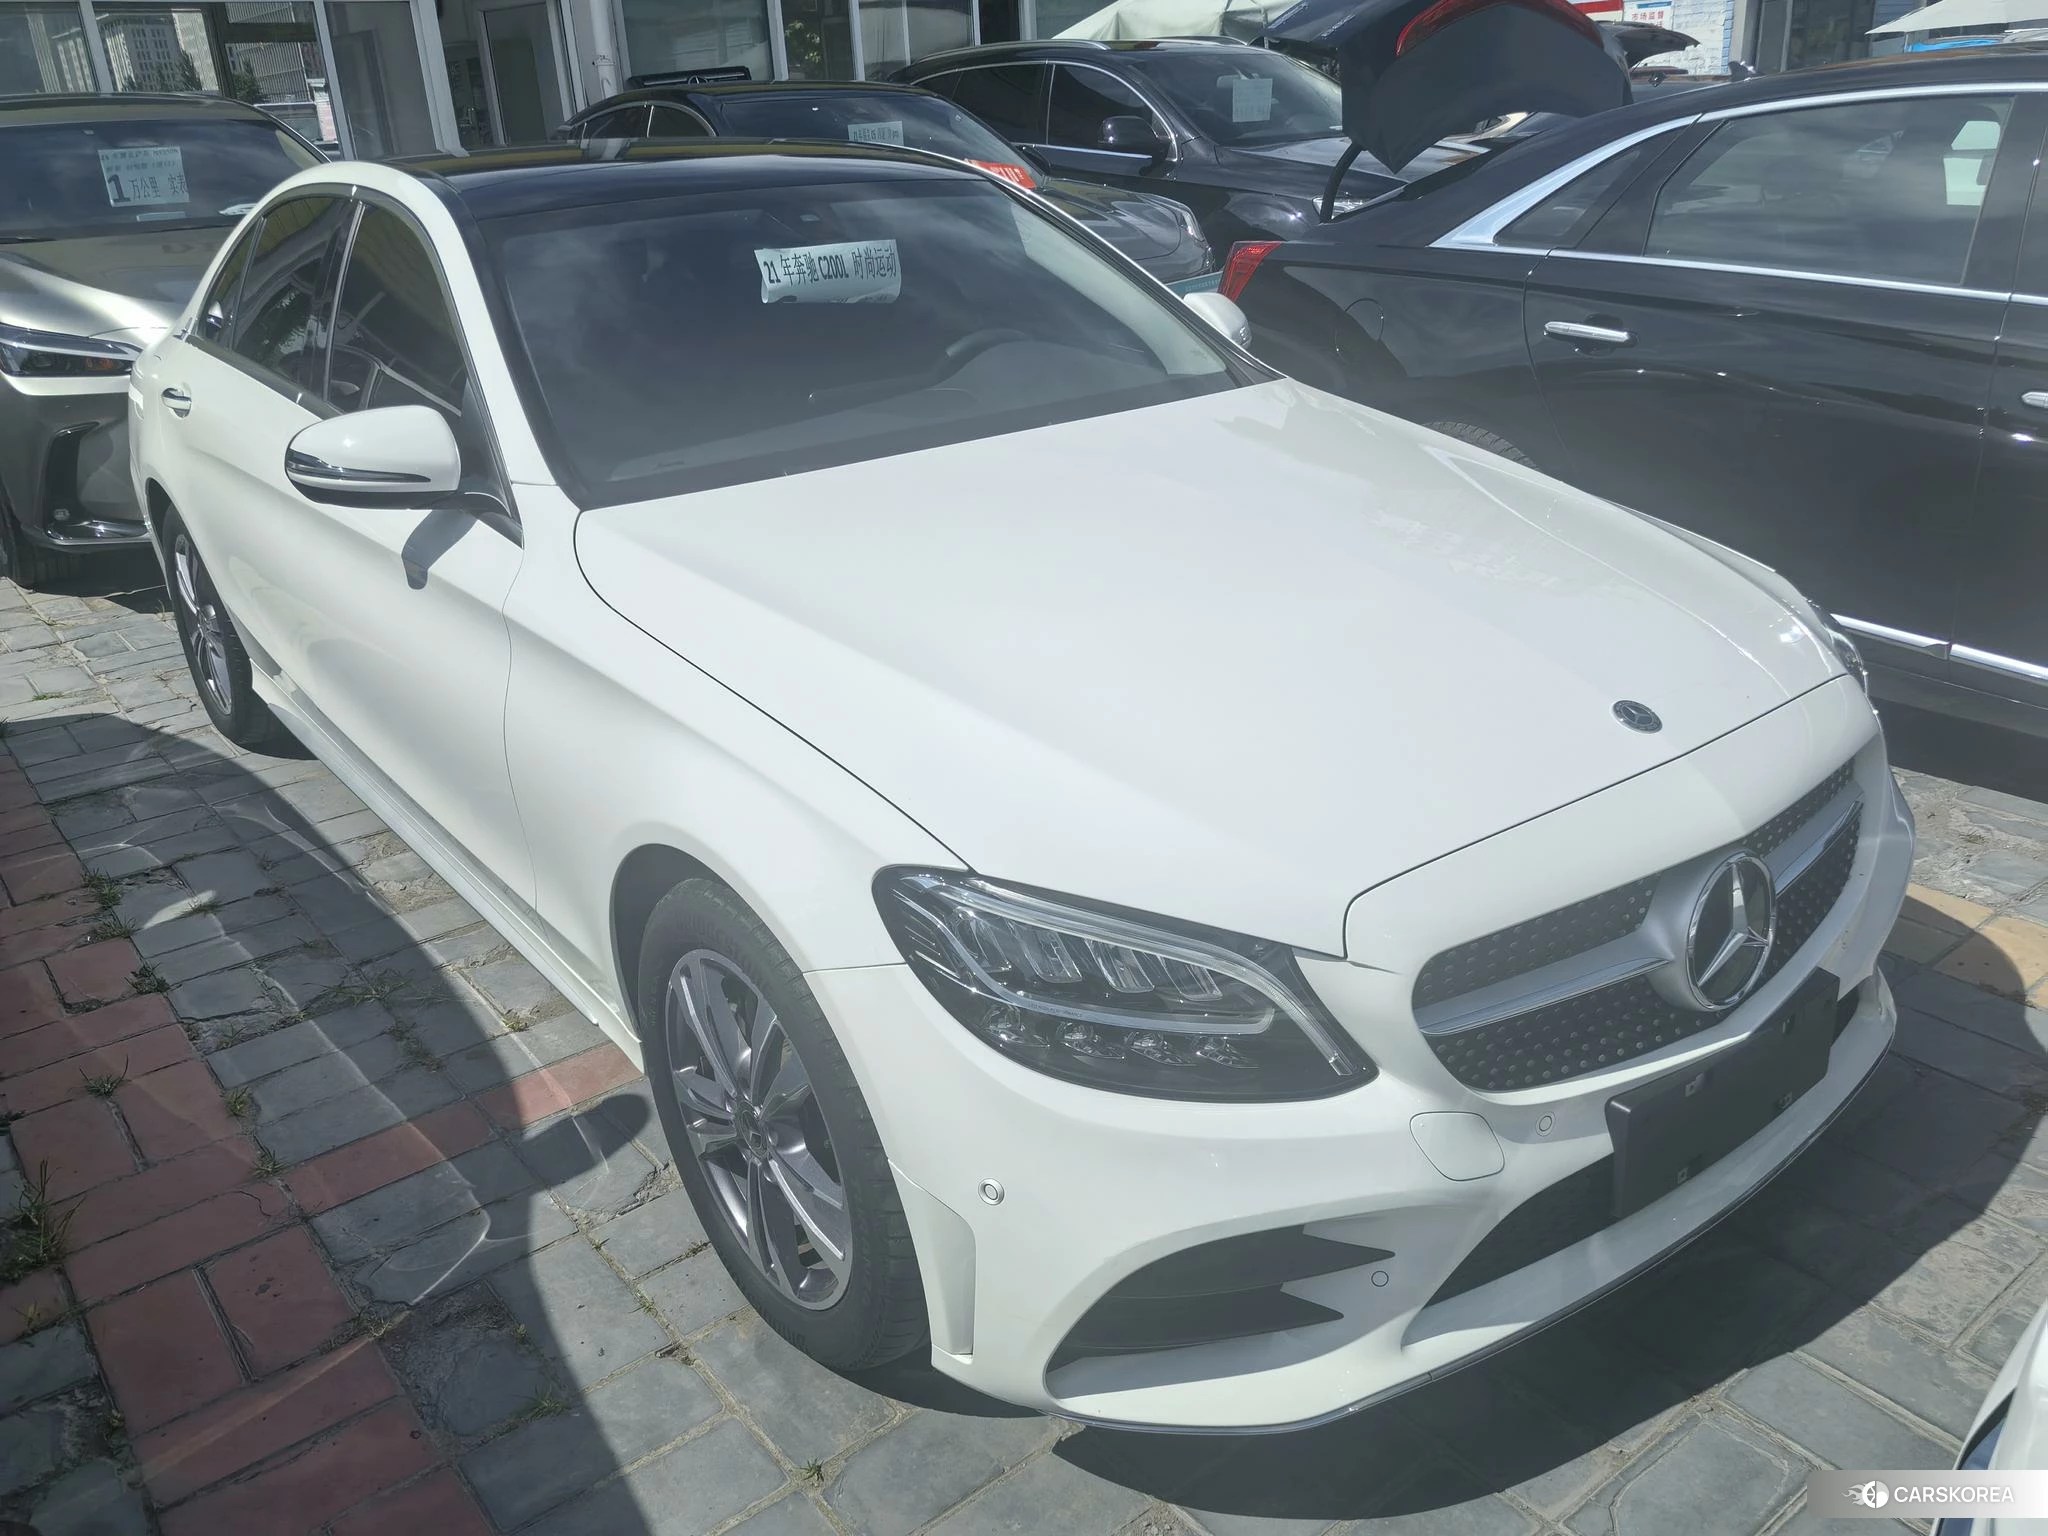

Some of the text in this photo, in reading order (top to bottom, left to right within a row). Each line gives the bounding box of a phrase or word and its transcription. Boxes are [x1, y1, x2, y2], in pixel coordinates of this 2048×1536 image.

[107, 174, 131, 203] 1
[128, 176, 161, 200] 万公里
